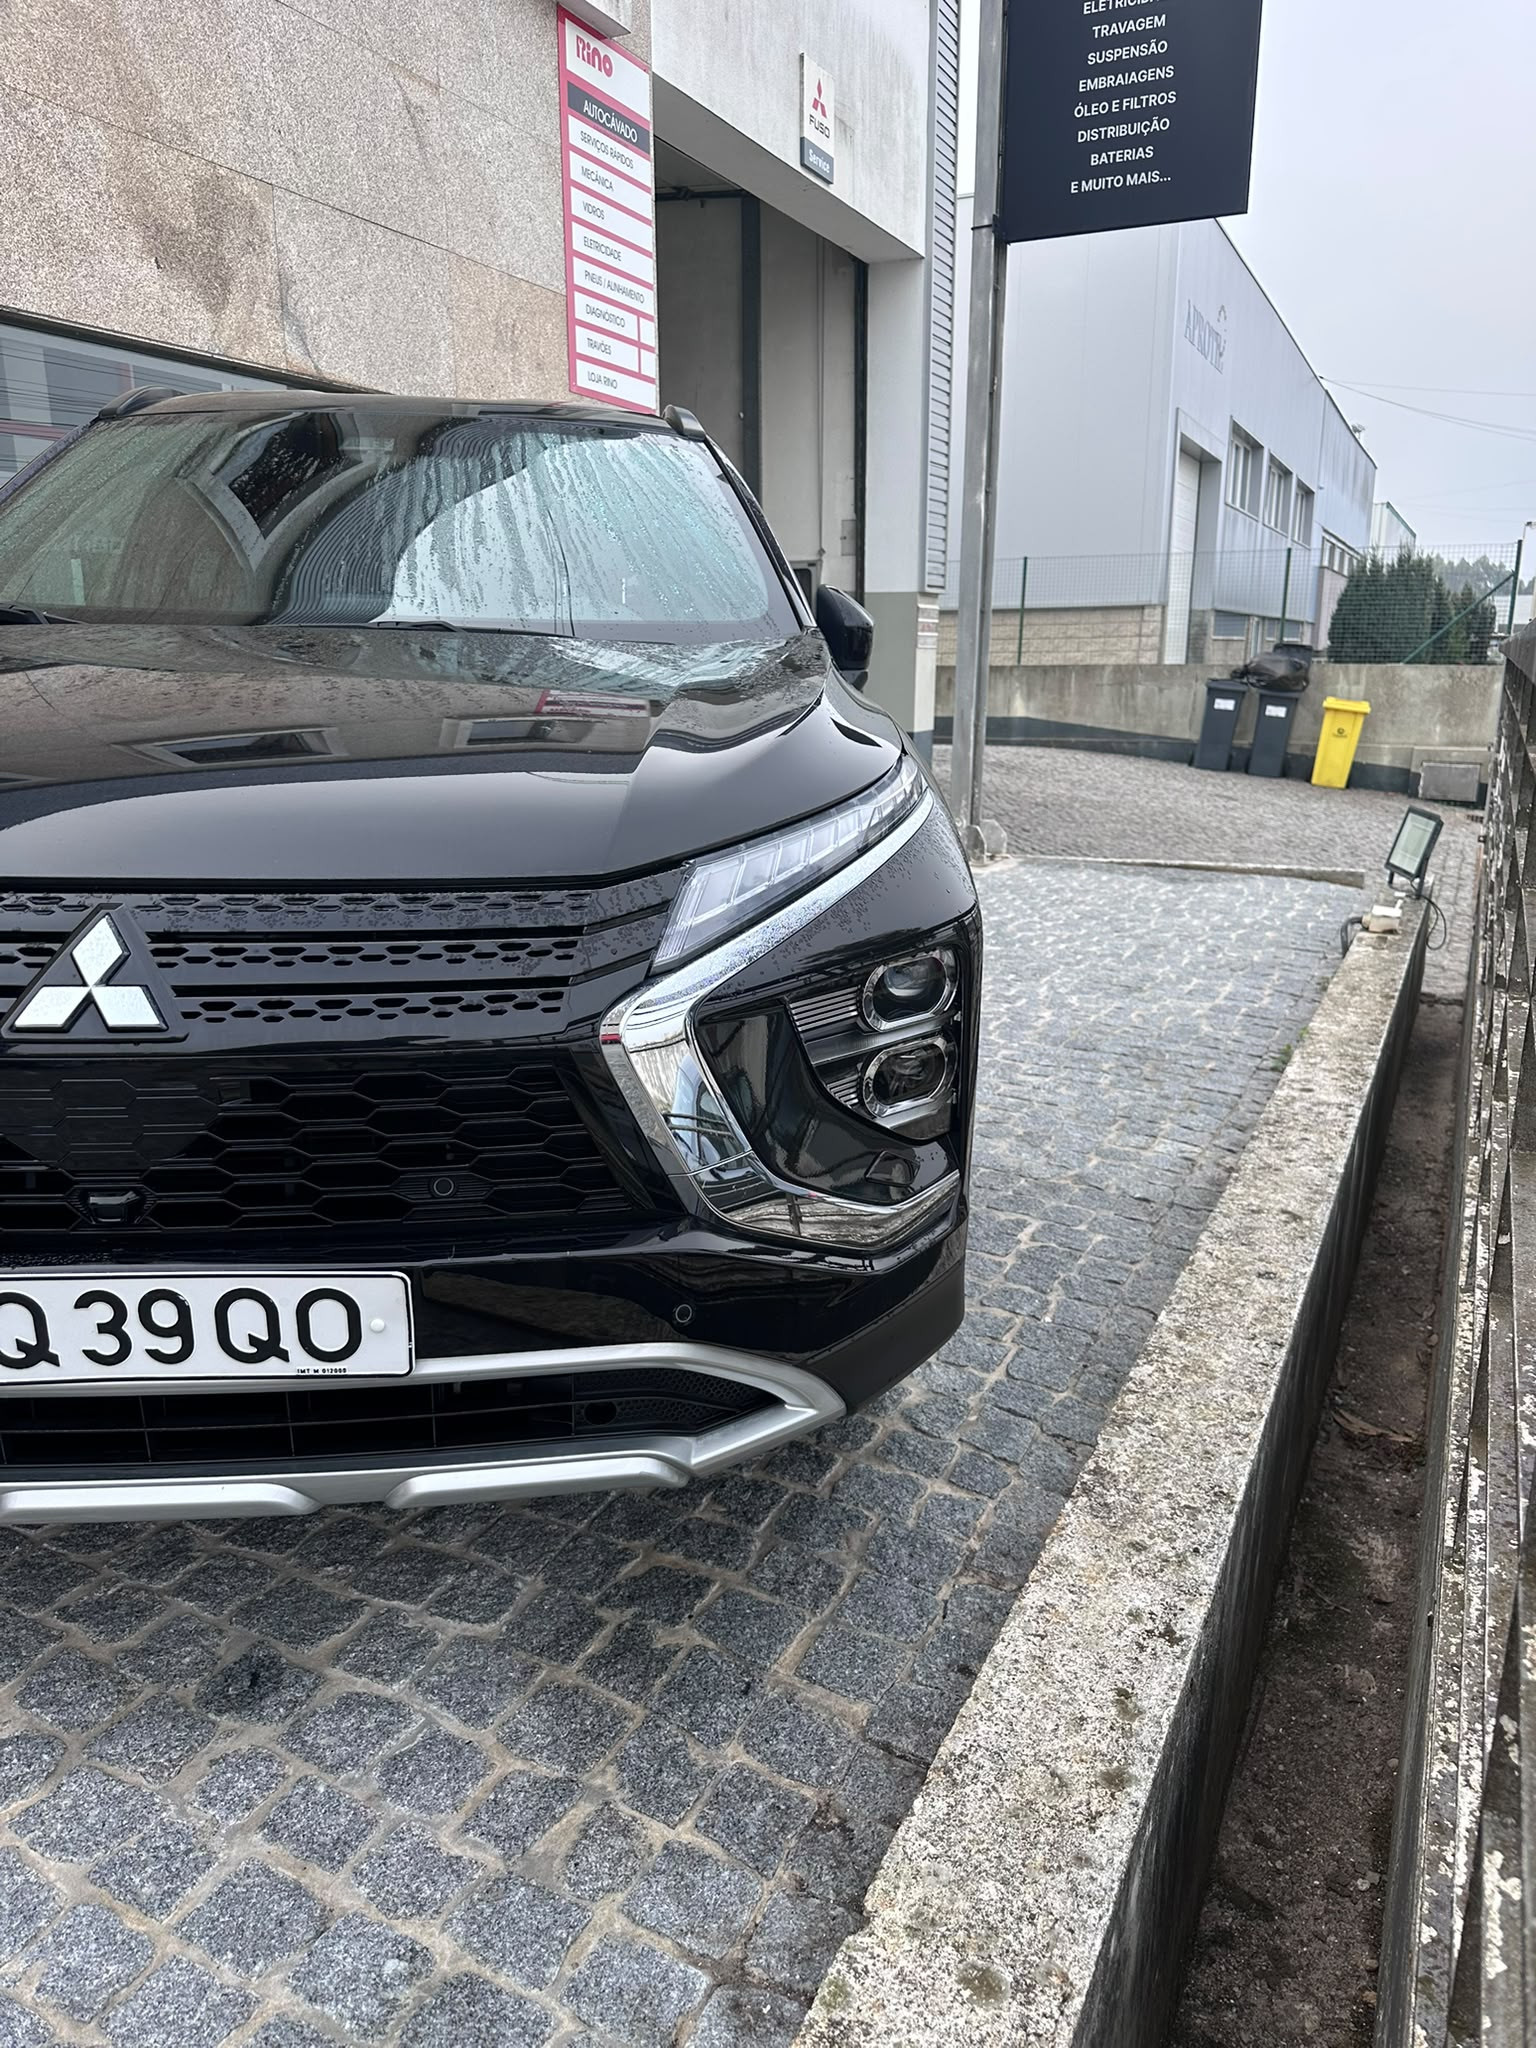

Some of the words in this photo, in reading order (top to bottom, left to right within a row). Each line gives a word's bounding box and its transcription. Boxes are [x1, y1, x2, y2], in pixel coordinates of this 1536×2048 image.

[1092, 13, 1166, 39] TRAVAGEM
[1087, 38, 1168, 66] SUSPENSÃO
[1078, 65, 1175, 92] EMBRAIAGENS
[1074, 101, 1109, 118] ÓLEO
[1111, 100, 1120, 112] E
[1122, 91, 1177, 111] FILTROS
[583, 100, 638, 144] AUTOCÁVADO
[809, 114, 831, 139] FUSO
[1077, 116, 1170, 143] DISTRIBUIÇÃO
[580, 130, 609, 155] SERVIÇOS
[609, 146, 634, 170] RÁPIDOS
[808, 148, 831, 174] Service
[1090, 145, 1154, 167] BATERIAS
[581, 166, 614, 192] MECÂNICA
[1070, 181, 1079, 194] E
[1081, 175, 1124, 193] MUITO
[583, 201, 605, 221] VIDROS
[583, 236, 622, 262] ELETRICIDADE
[584, 269, 603, 288] PNEUS
[607, 280, 645, 304] ALINHAMENTO
[585, 304, 626, 328] DIAGNÓSTICO
[587, 337, 612, 355] TRAVÕES
[587, 370, 603, 385] LOJA
[603, 375, 618, 390] RINO
[73, 1288, 196, 1367] 39
[213, 1285, 363, 1364] QO
